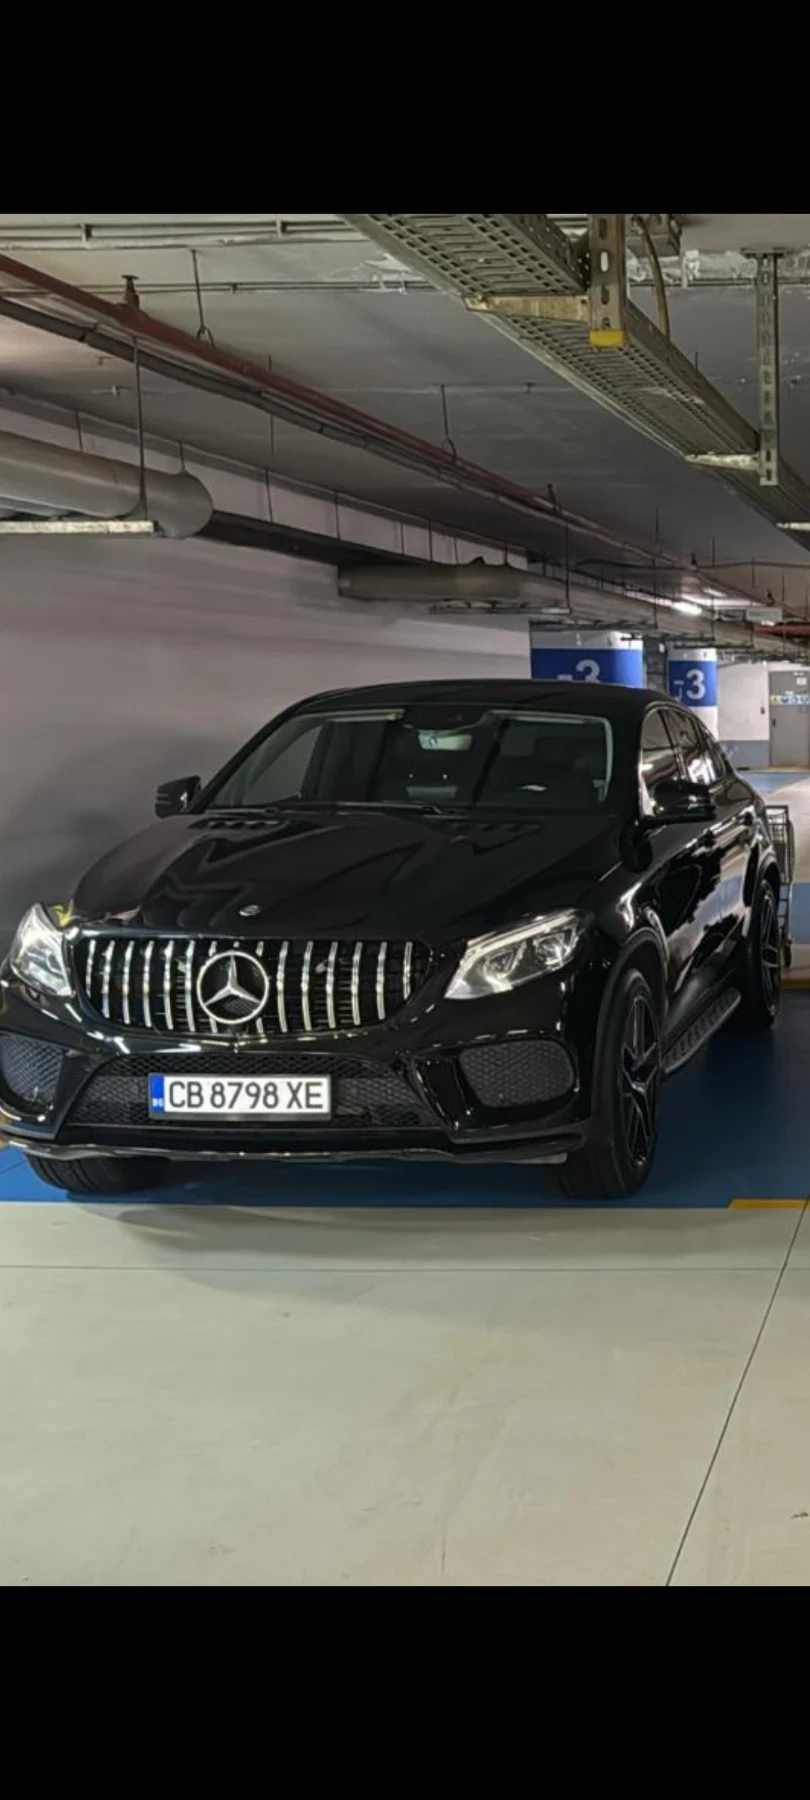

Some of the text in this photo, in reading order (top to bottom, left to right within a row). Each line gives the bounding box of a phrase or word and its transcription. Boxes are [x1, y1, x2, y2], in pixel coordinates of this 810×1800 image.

[673, 669, 706, 700] -3
[169, 1081, 323, 1109] CB 8798 XE
